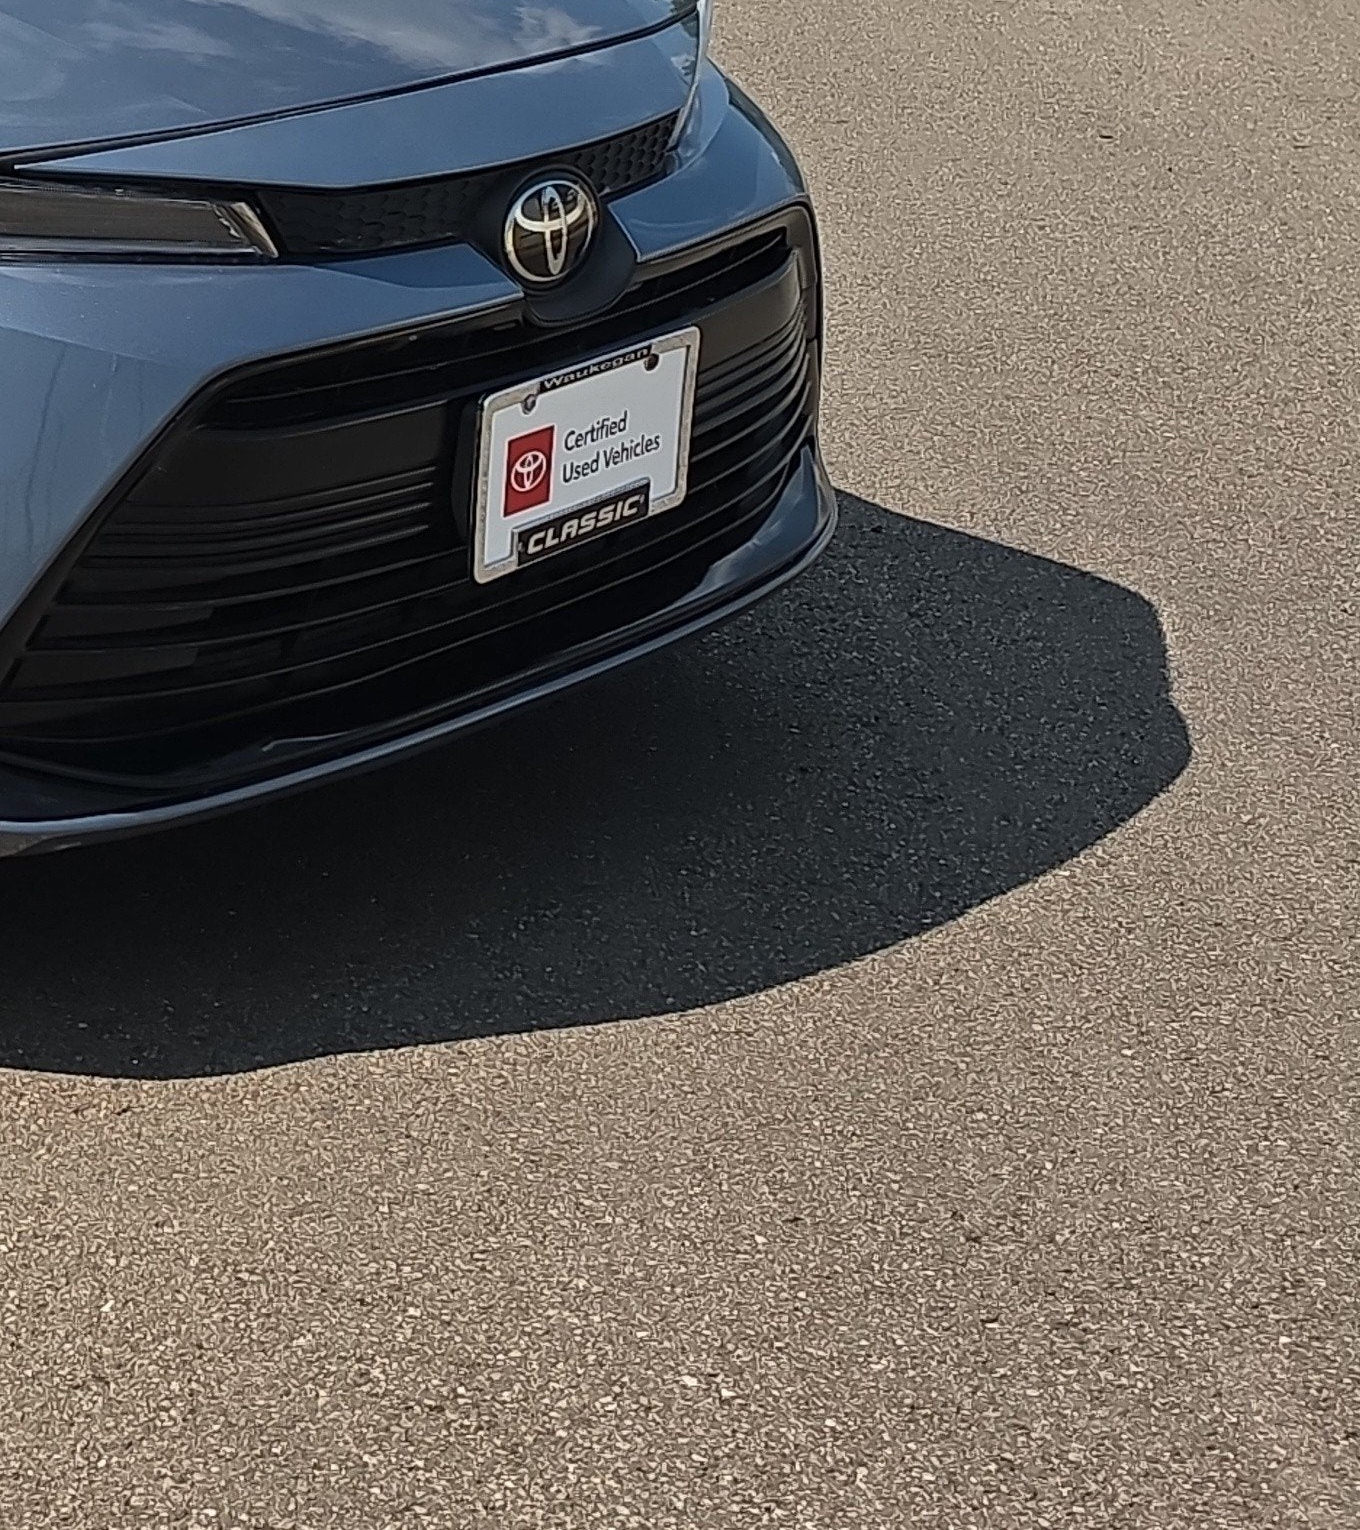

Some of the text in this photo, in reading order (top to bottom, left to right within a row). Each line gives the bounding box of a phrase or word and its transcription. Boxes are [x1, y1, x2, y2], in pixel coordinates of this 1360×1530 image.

[543, 348, 649, 389] Waukegan
[563, 409, 628, 452] Certified
[562, 434, 661, 484] Used Vehicles
[526, 493, 642, 555] CLASSIC
